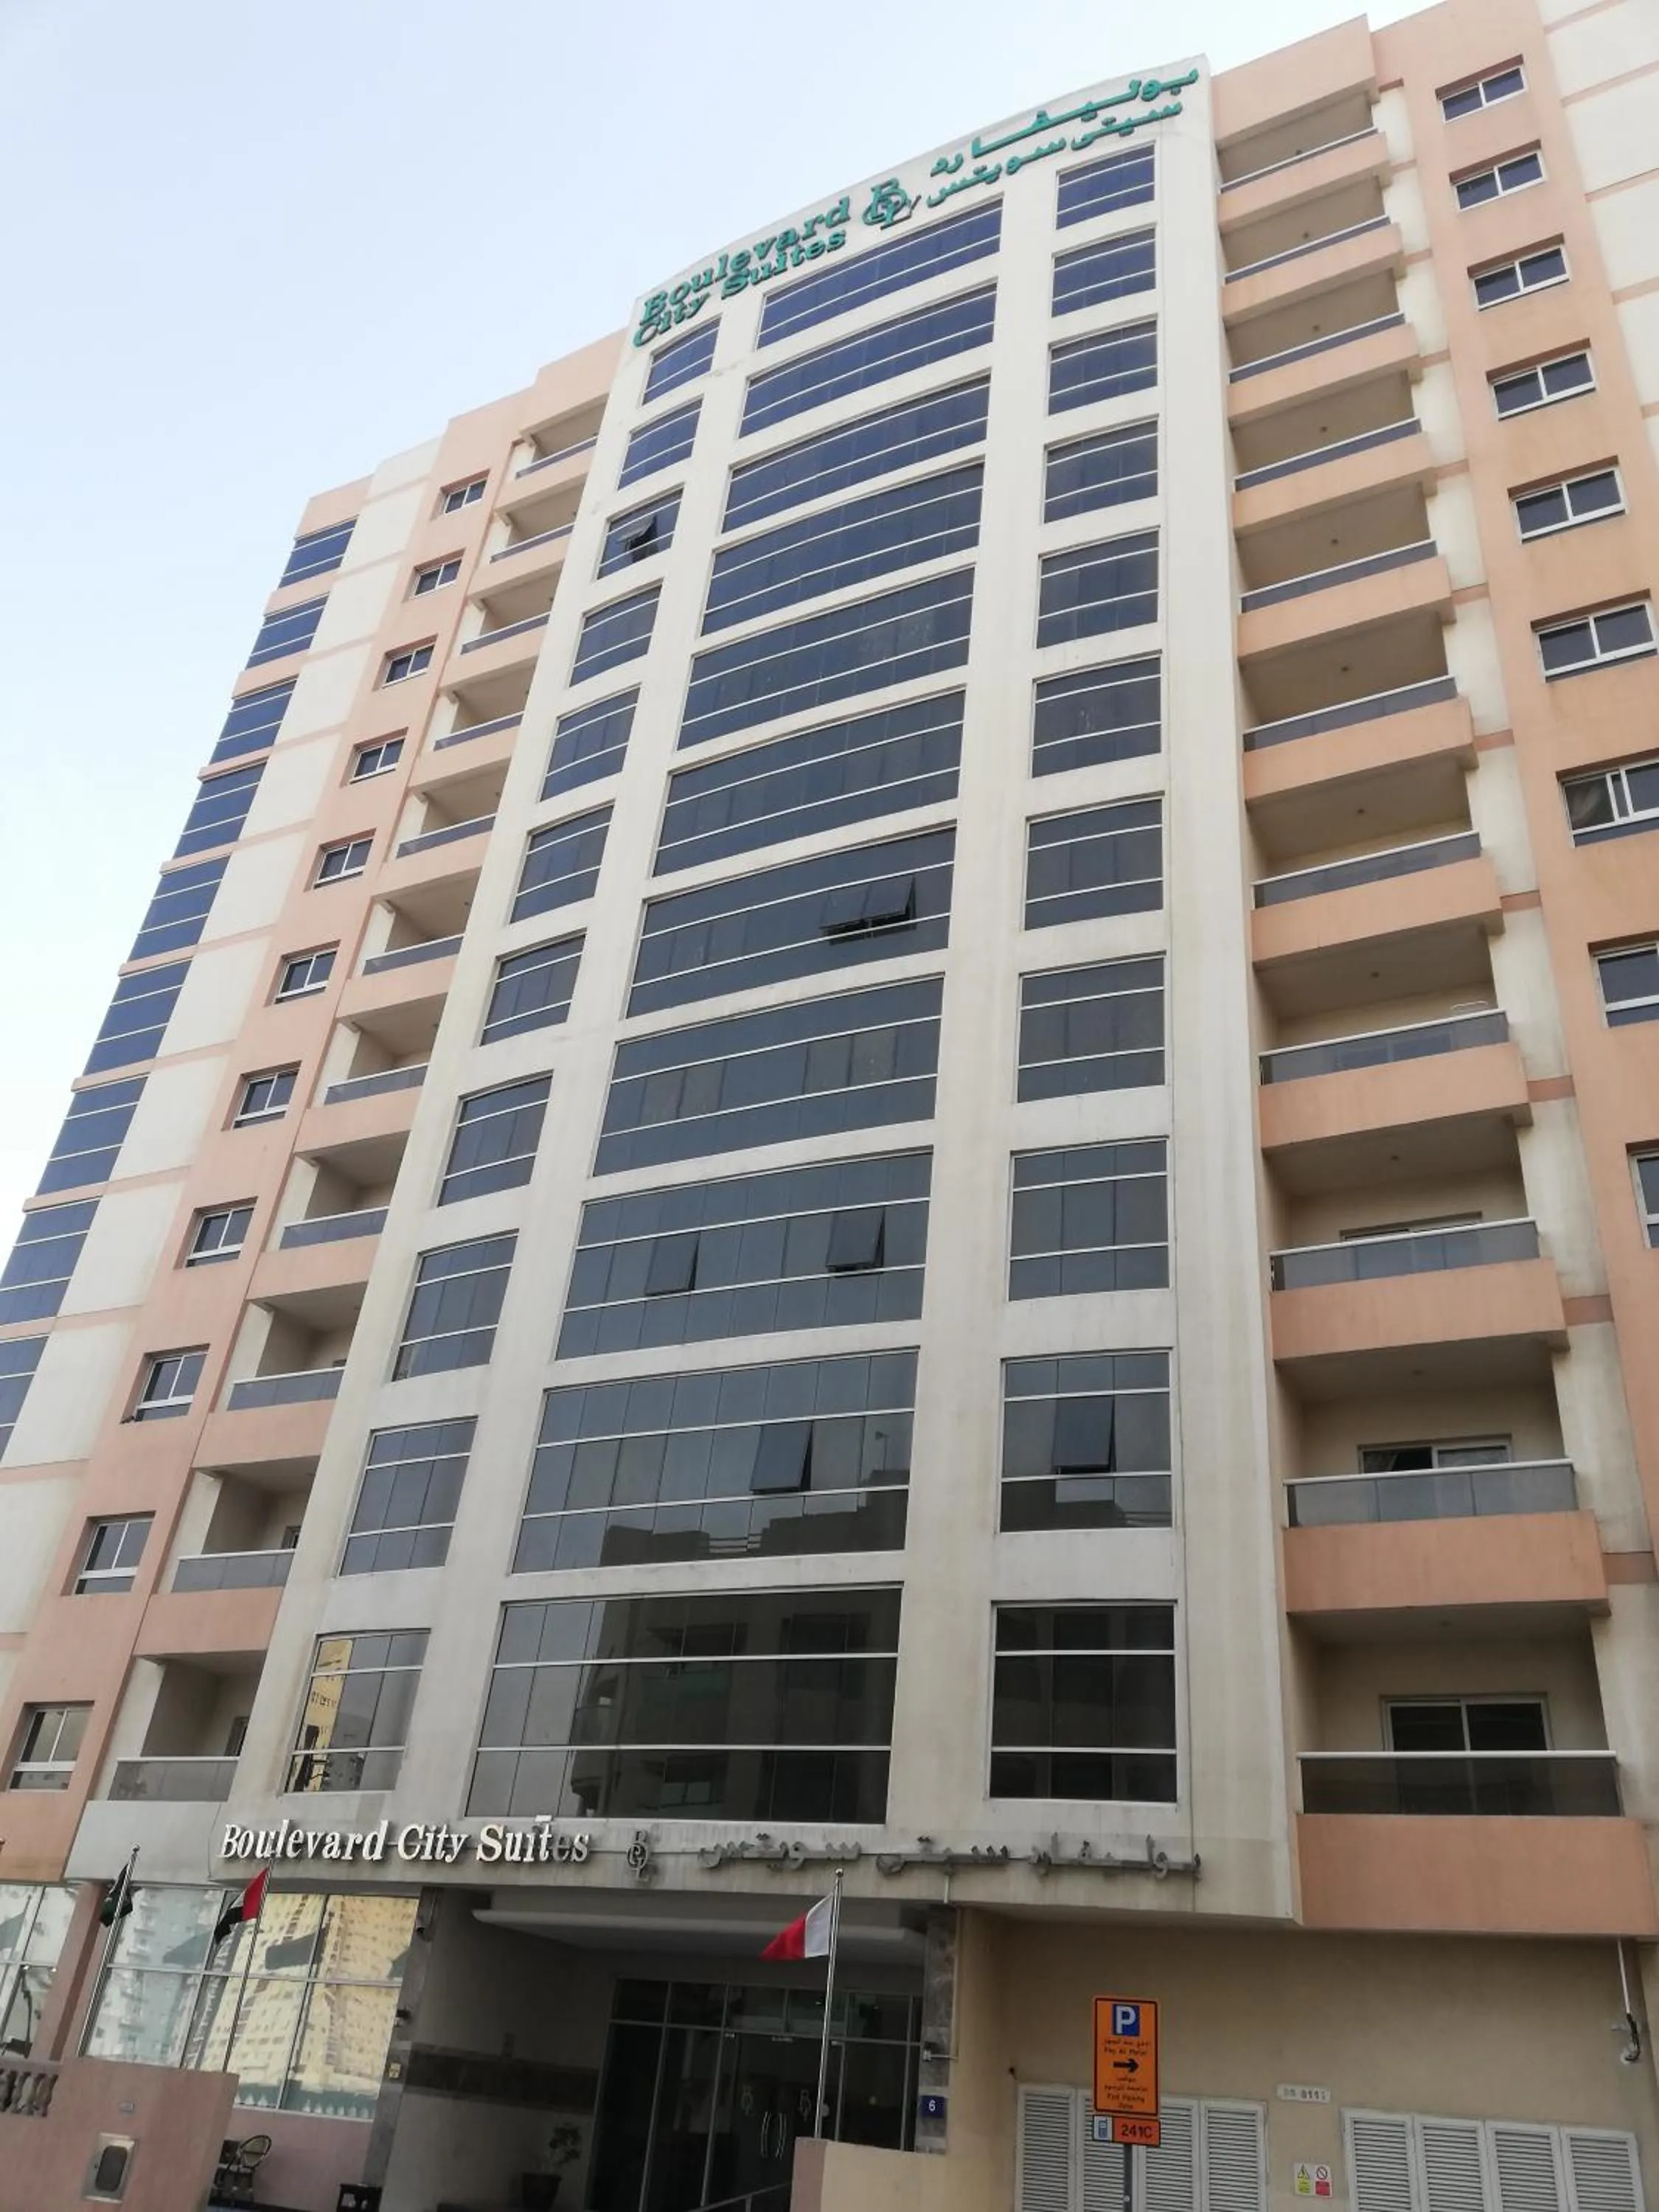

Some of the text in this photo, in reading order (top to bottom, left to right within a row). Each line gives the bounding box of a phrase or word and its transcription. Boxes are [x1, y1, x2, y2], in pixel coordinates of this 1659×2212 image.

[639, 195, 852, 327] Boulevard
[633, 229, 847, 347] City Suites
[220, 1819, 389, 1861] Boulevard
[396, 1823, 470, 1863] City
[475, 1821, 591, 1863] Suites
[1116, 2005, 1136, 2035] P
[928, 2099, 936, 2112] 6
[1121, 2124, 1152, 2138] 241C
